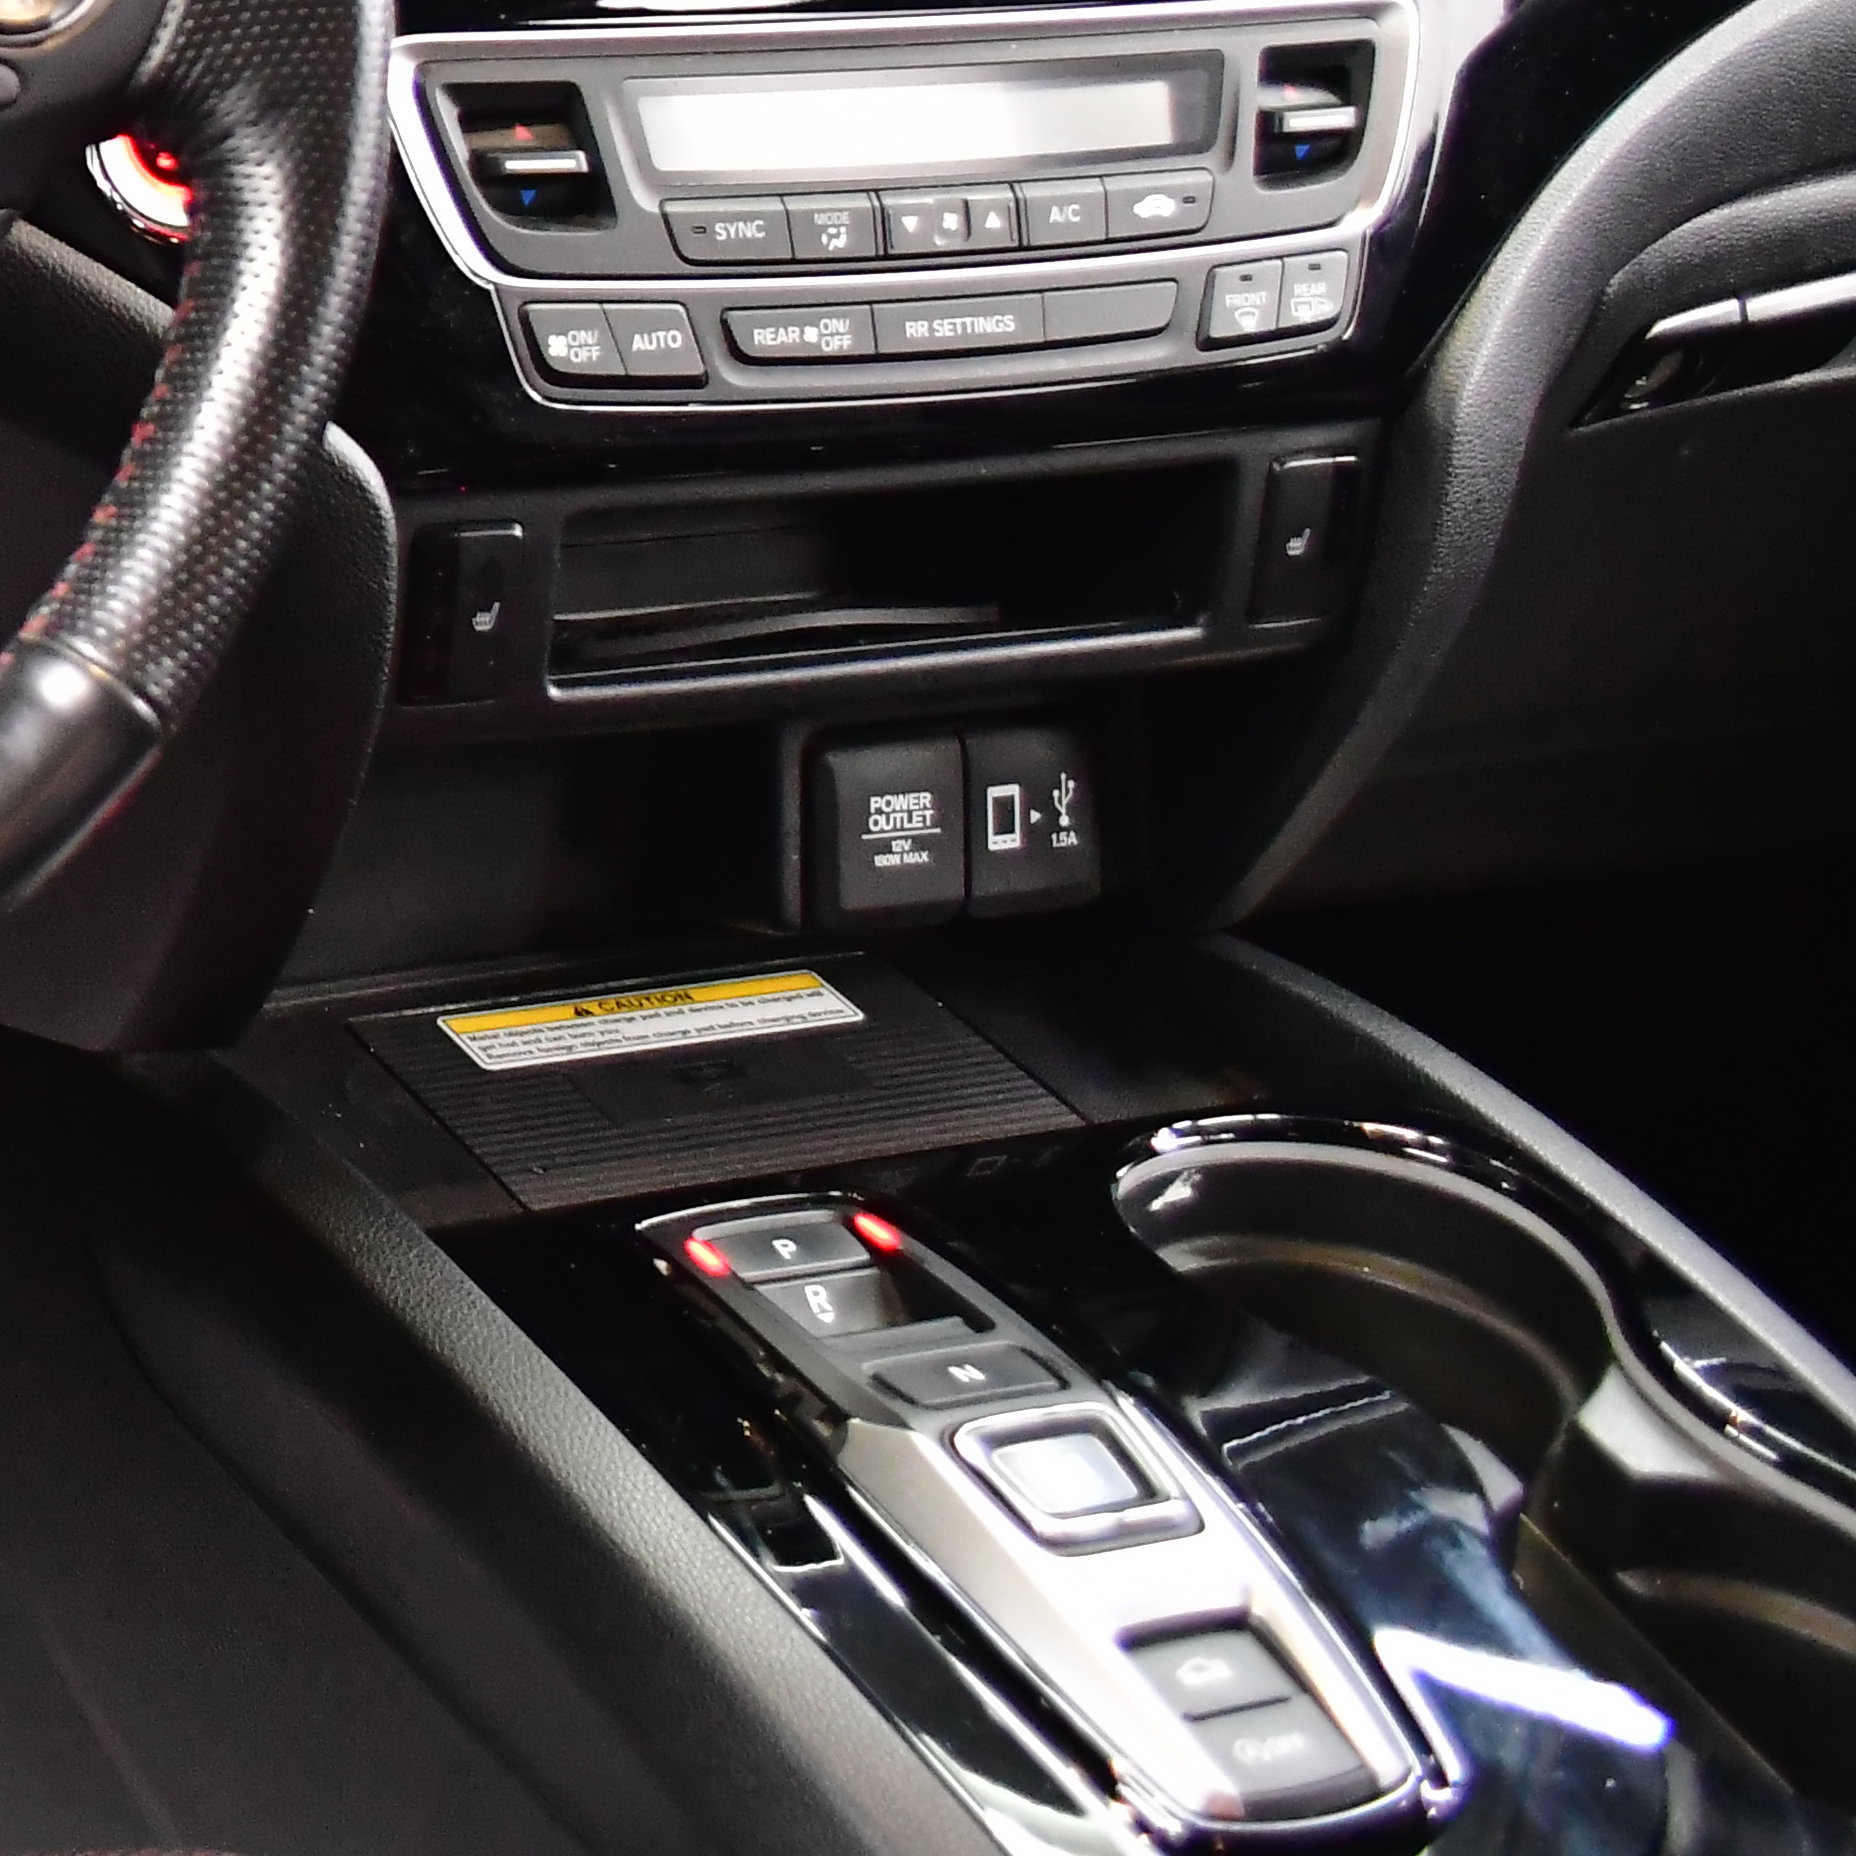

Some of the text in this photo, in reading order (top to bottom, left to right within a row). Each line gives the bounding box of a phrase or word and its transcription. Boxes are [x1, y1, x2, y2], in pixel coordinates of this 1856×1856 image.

[814, 211, 850, 226] MODE
[1049, 204, 1081, 224] A/C
[714, 219, 766, 241] SYNC
[1293, 282, 1327, 297] REAR
[1225, 292, 1267, 308] FRONT
[819, 318, 851, 335] ON/
[904, 314, 1016, 339] RR SETTINGS
[566, 330, 599, 349] ON/
[631, 331, 683, 353] AUTO
[752, 327, 801, 347] REAR
[821, 333, 853, 352] OFF
[569, 345, 601, 364] OFF
[870, 791, 932, 813] POWER
[868, 809, 934, 832] OUTLET
[891, 839, 913, 852] 12V
[1050, 830, 1079, 848] 1.5A
[903, 850, 930, 864] MAX
[598, 990, 694, 1013] CAUTION
[772, 1238, 797, 1260] P
[804, 1284, 834, 1313] R
[948, 1363, 986, 1383] N
